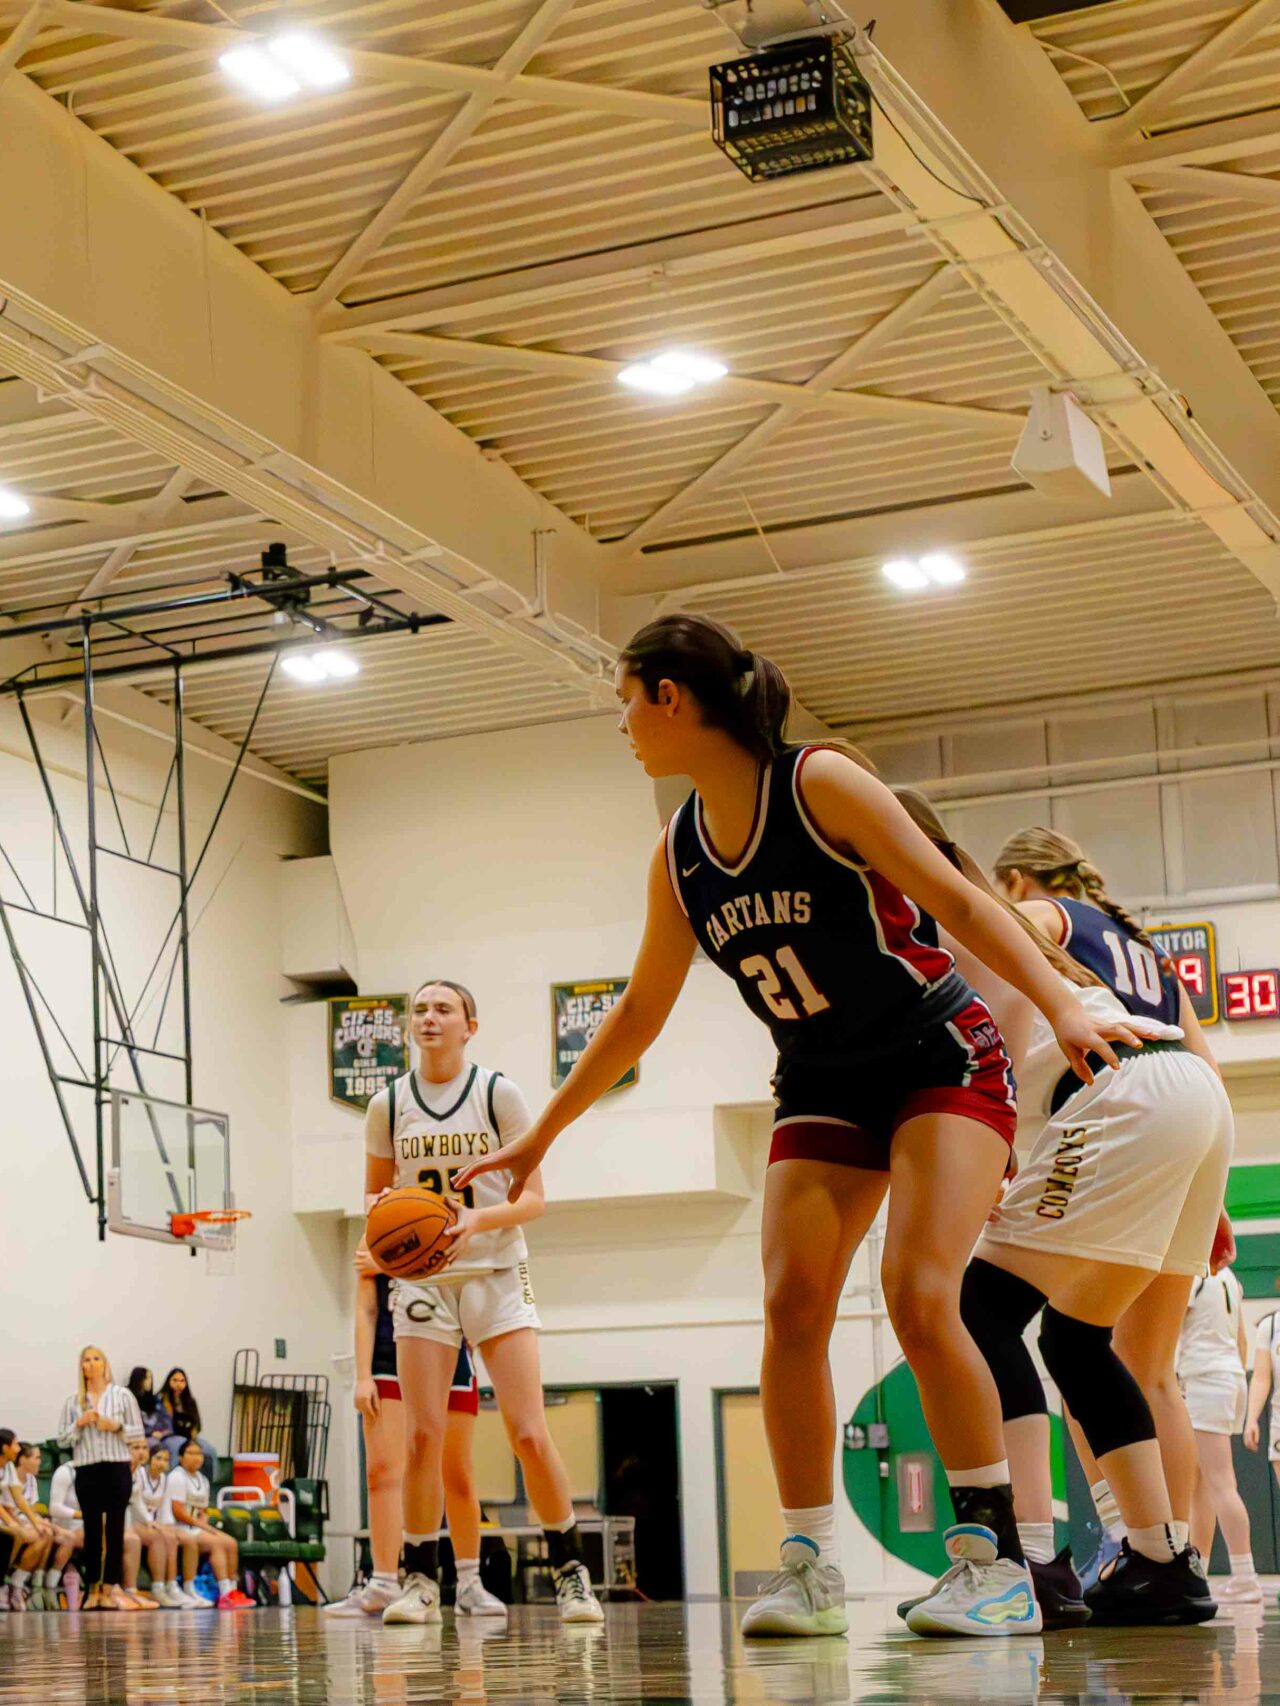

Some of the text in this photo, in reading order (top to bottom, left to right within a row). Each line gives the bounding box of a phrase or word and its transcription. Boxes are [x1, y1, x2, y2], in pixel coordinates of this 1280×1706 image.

[1153, 929, 1208, 951] SITOR
[740, 945, 831, 1020] 21
[1102, 930, 1162, 1007] 10
[1227, 975, 1277, 1015] 30
[401, 1133, 489, 1159] COWBOYS
